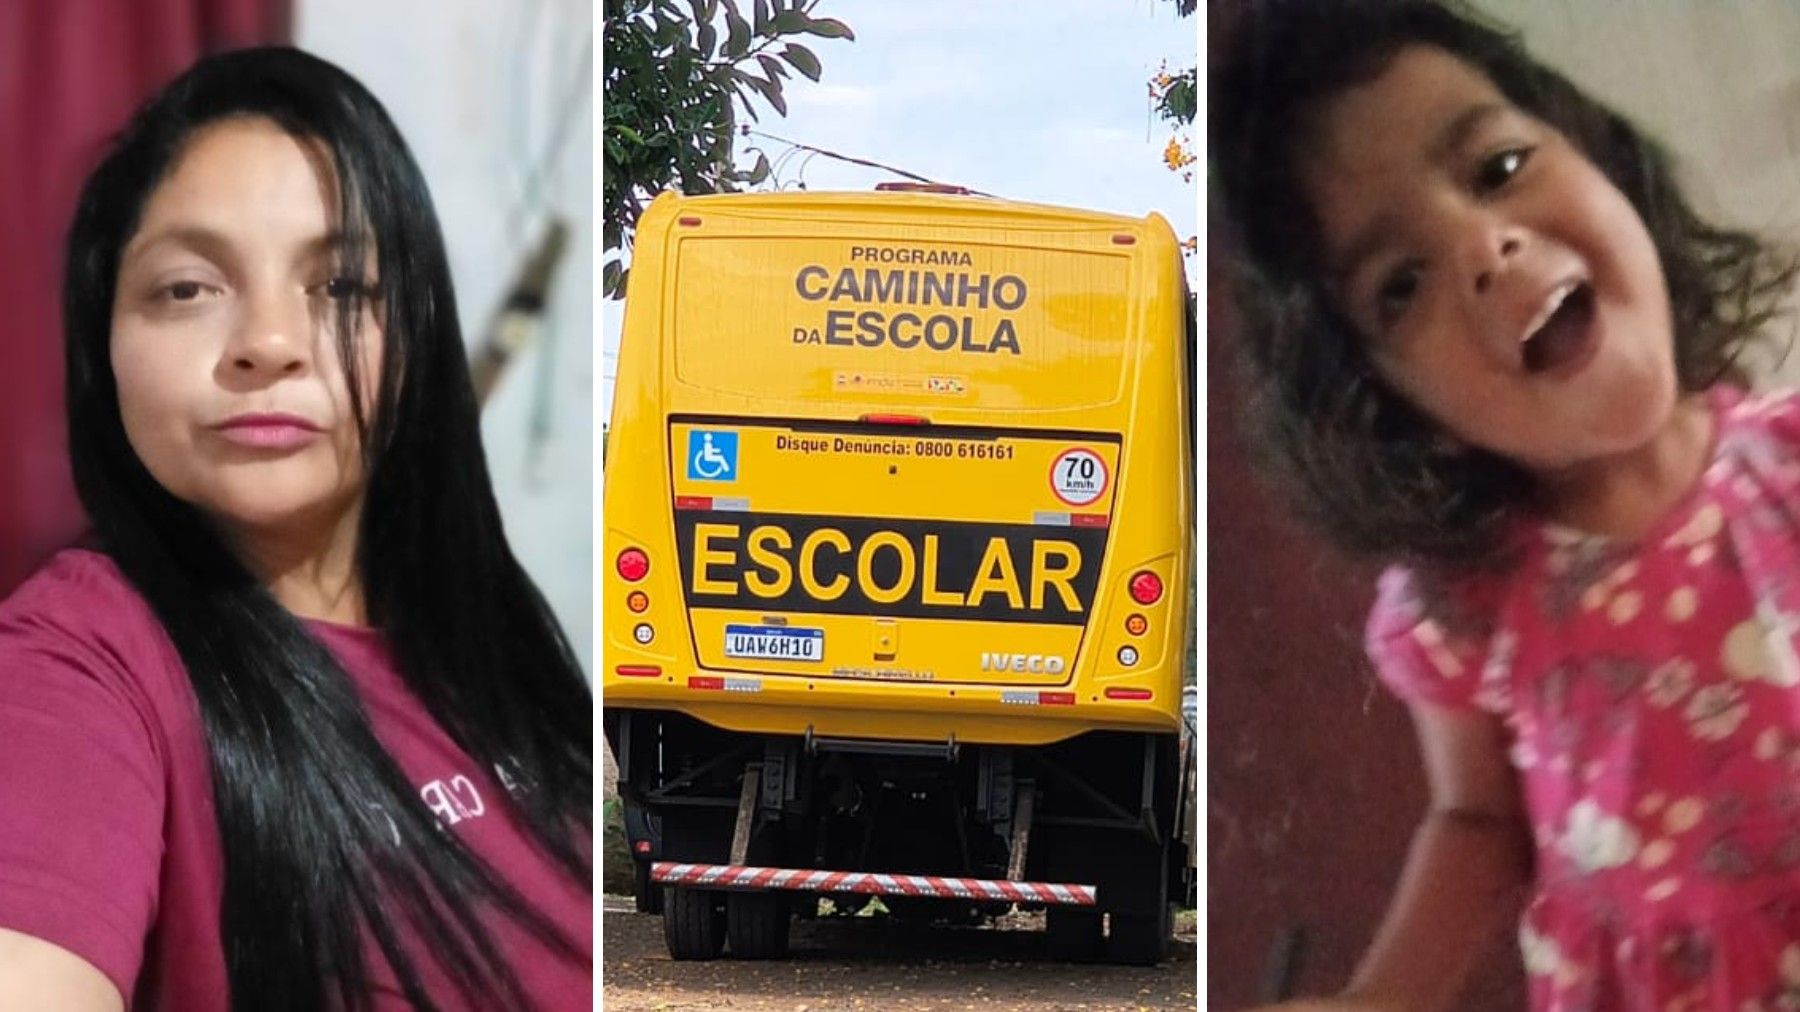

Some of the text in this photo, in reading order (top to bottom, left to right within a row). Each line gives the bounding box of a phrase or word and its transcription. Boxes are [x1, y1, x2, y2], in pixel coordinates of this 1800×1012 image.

[851, 247, 972, 266] PROGRAMA
[796, 265, 1027, 311] CAMINHO
[793, 310, 1020, 355] DA ESCOLA
[776, 436, 1014, 460] Disque Denúncia: 0800 616161
[1065, 457, 1095, 479] 70
[1066, 480, 1095, 489] km/h
[691, 523, 1085, 614] ESCOLAR
[734, 635, 814, 657] UAW6H10
[981, 652, 1064, 674] IVECO
